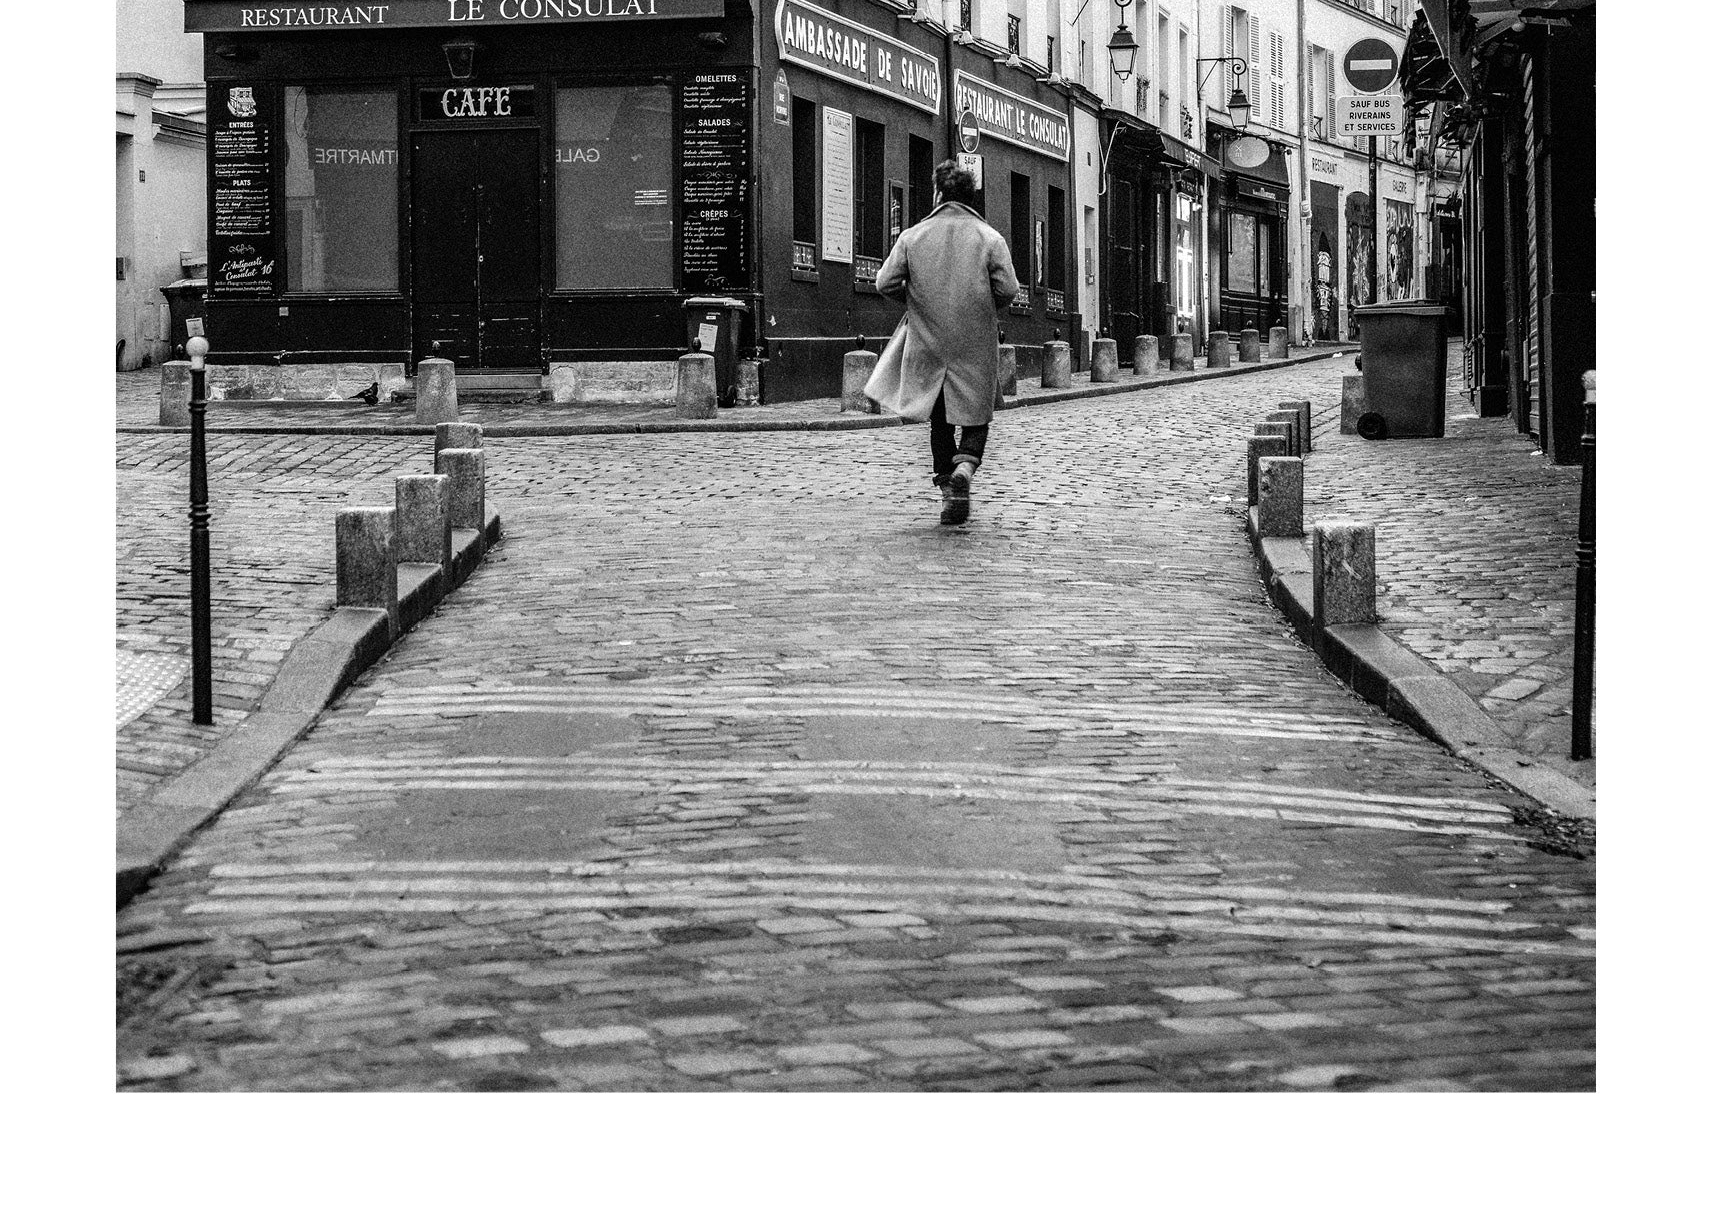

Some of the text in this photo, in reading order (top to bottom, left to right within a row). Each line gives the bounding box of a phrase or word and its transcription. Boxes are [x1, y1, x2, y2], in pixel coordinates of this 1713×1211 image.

[241, 5, 389, 27] RESTAURANT
[784, 11, 937, 101] AMBASSADE DE SAVOIE
[695, 74, 737, 83] OMELETTES
[441, 86, 512, 118] CAFE
[1350, 100, 1391, 108] SAUF BUS
[957, 83, 1067, 150] RESTAURANT LE CONSULAT
[1349, 111, 1391, 119] RIVERAINS
[698, 119, 731, 127] SALADES
[1344, 122, 1396, 131] ET SERVICES
[700, 209, 729, 218] CRÊPES
